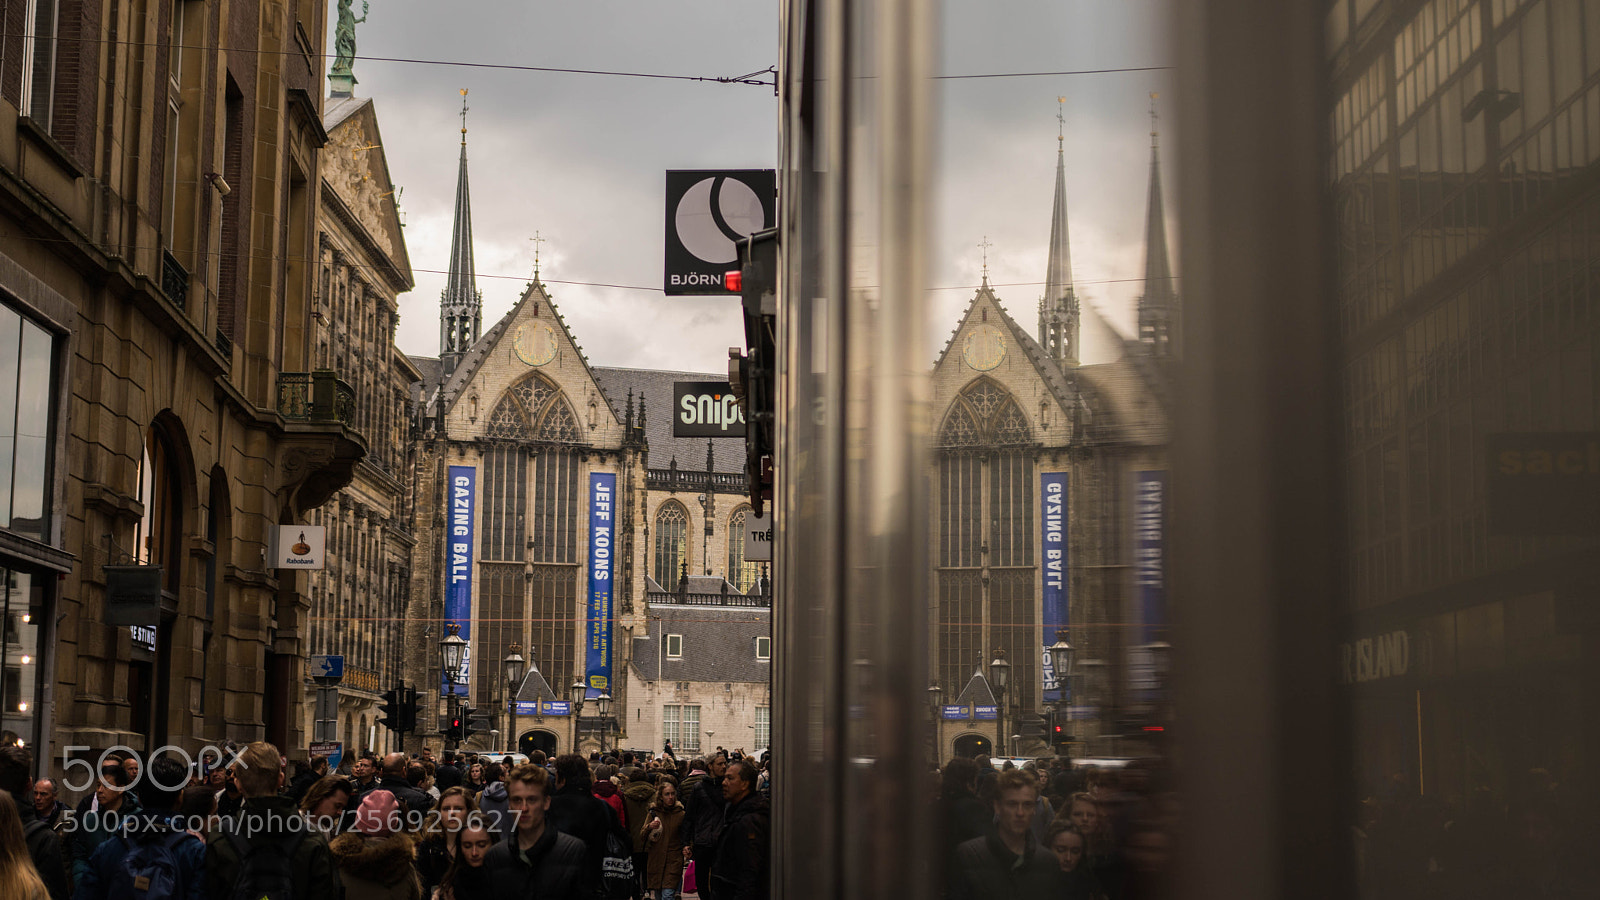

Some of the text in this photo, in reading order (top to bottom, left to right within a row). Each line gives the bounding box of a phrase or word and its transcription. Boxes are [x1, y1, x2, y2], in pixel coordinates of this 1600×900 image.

[670, 271, 721, 286] BJÖRN
[453, 476, 470, 536] GAZING
[594, 482, 610, 580] JEFF KOONS
[286, 557, 315, 566] Rabobank
[452, 543, 468, 584] BALL
[138, 626, 155, 645] STING
[1356, 630, 1409, 682] ISLAND
